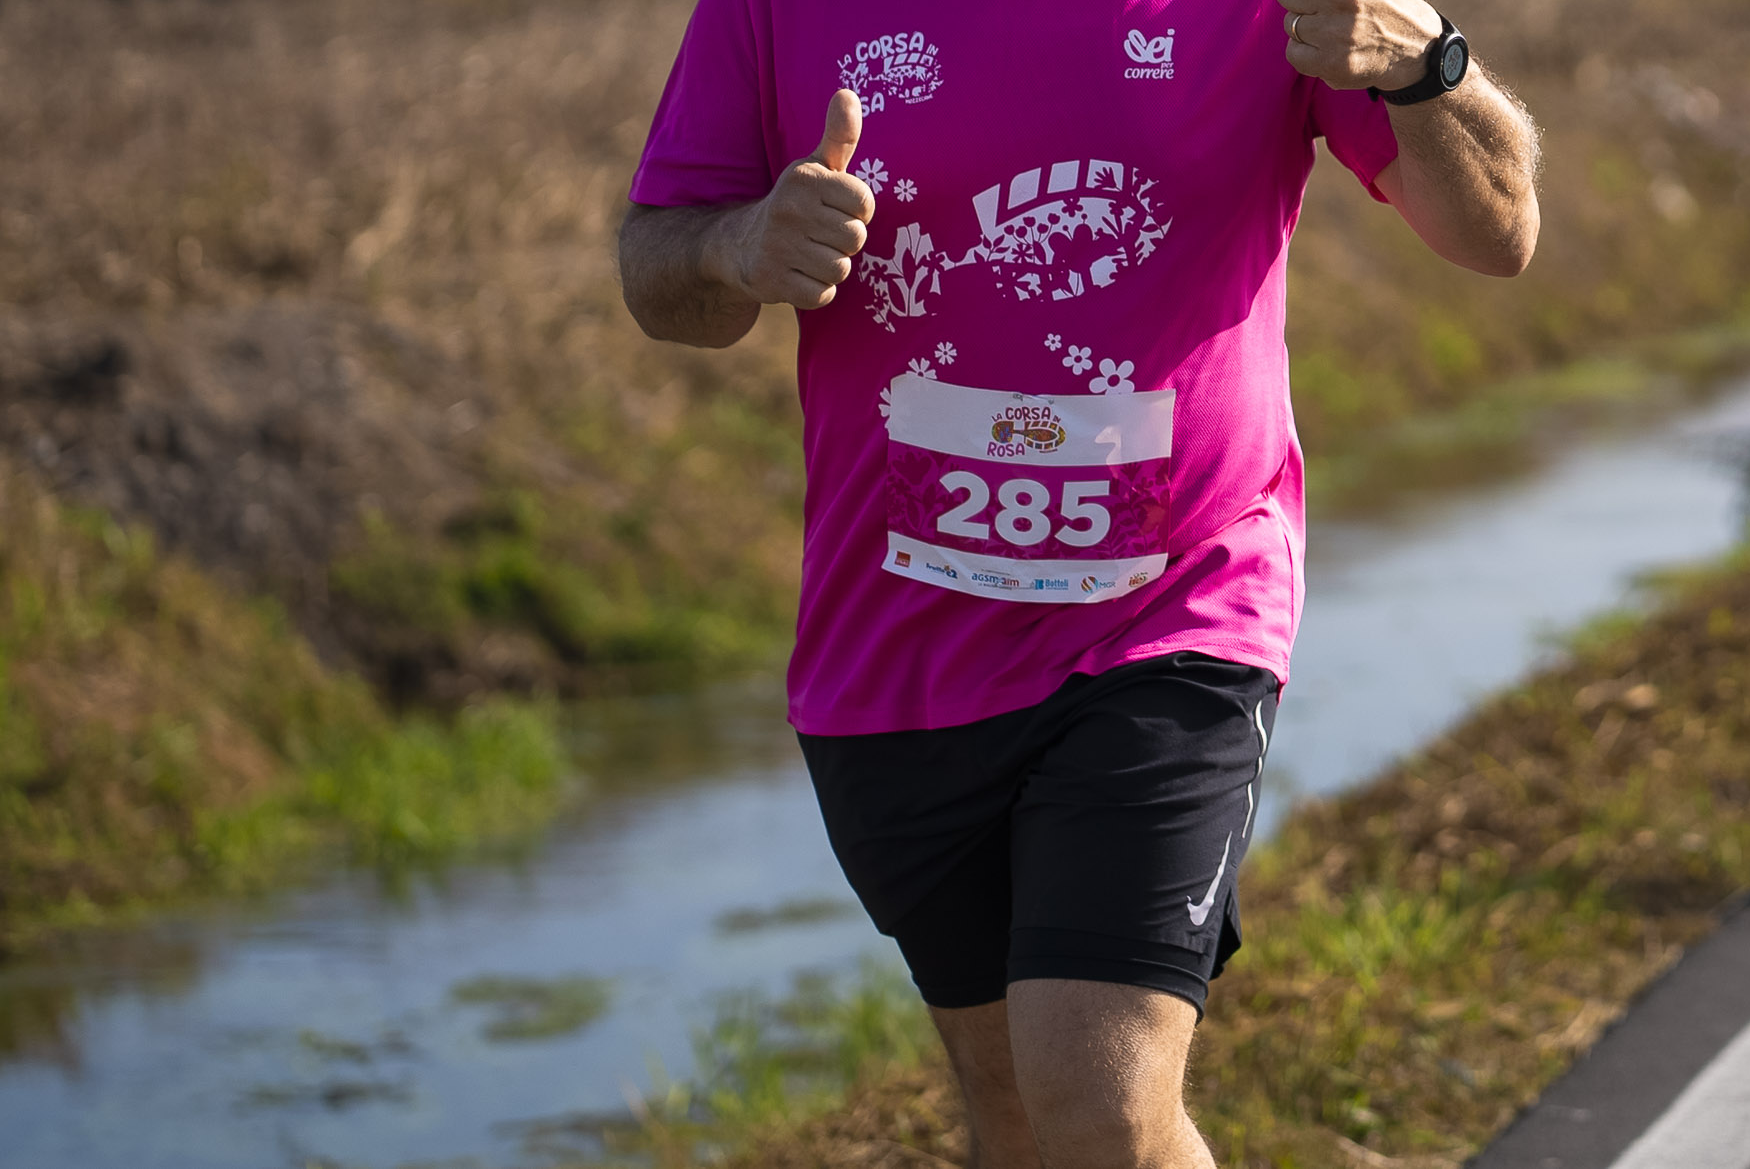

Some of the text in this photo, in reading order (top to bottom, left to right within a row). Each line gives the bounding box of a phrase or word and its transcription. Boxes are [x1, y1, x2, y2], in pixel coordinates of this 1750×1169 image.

[837, 31, 939, 69] LA CORSA IN
[1123, 28, 1175, 63] Sei
[1124, 67, 1175, 80] correre
[860, 91, 885, 118] SA
[991, 406, 1061, 423] LA CORSA IN
[986, 441, 1025, 458] ROSA
[937, 470, 1111, 547] 285
